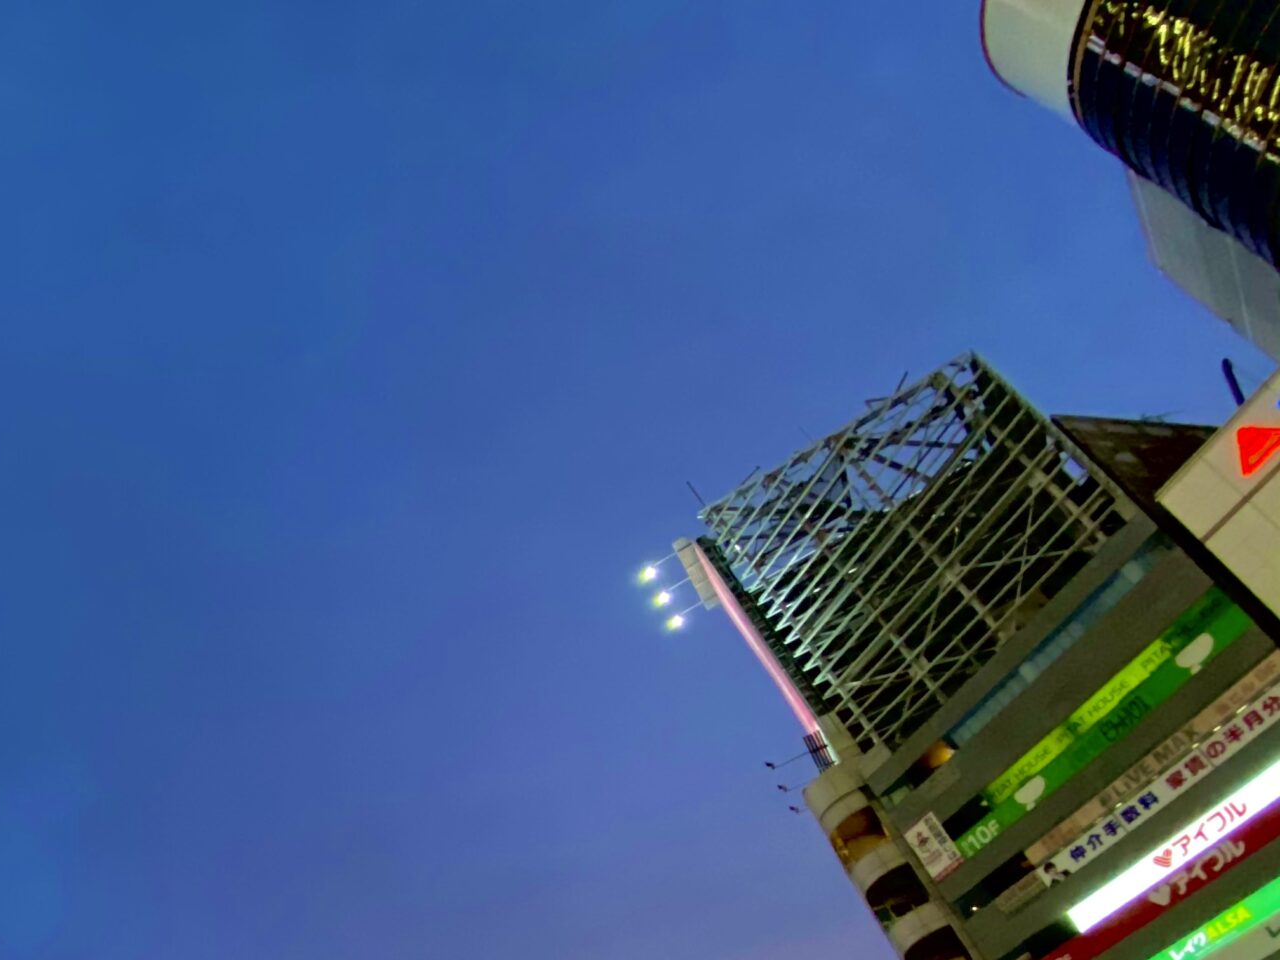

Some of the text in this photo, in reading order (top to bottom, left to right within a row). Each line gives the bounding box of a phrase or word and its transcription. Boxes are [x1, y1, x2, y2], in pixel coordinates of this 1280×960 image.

[1088, 680, 1129, 718] HOUSE
[1154, 724, 1199, 764] MAX
[1172, 801, 1247, 856] アイフル
[1173, 838, 1246, 895] アイフル
